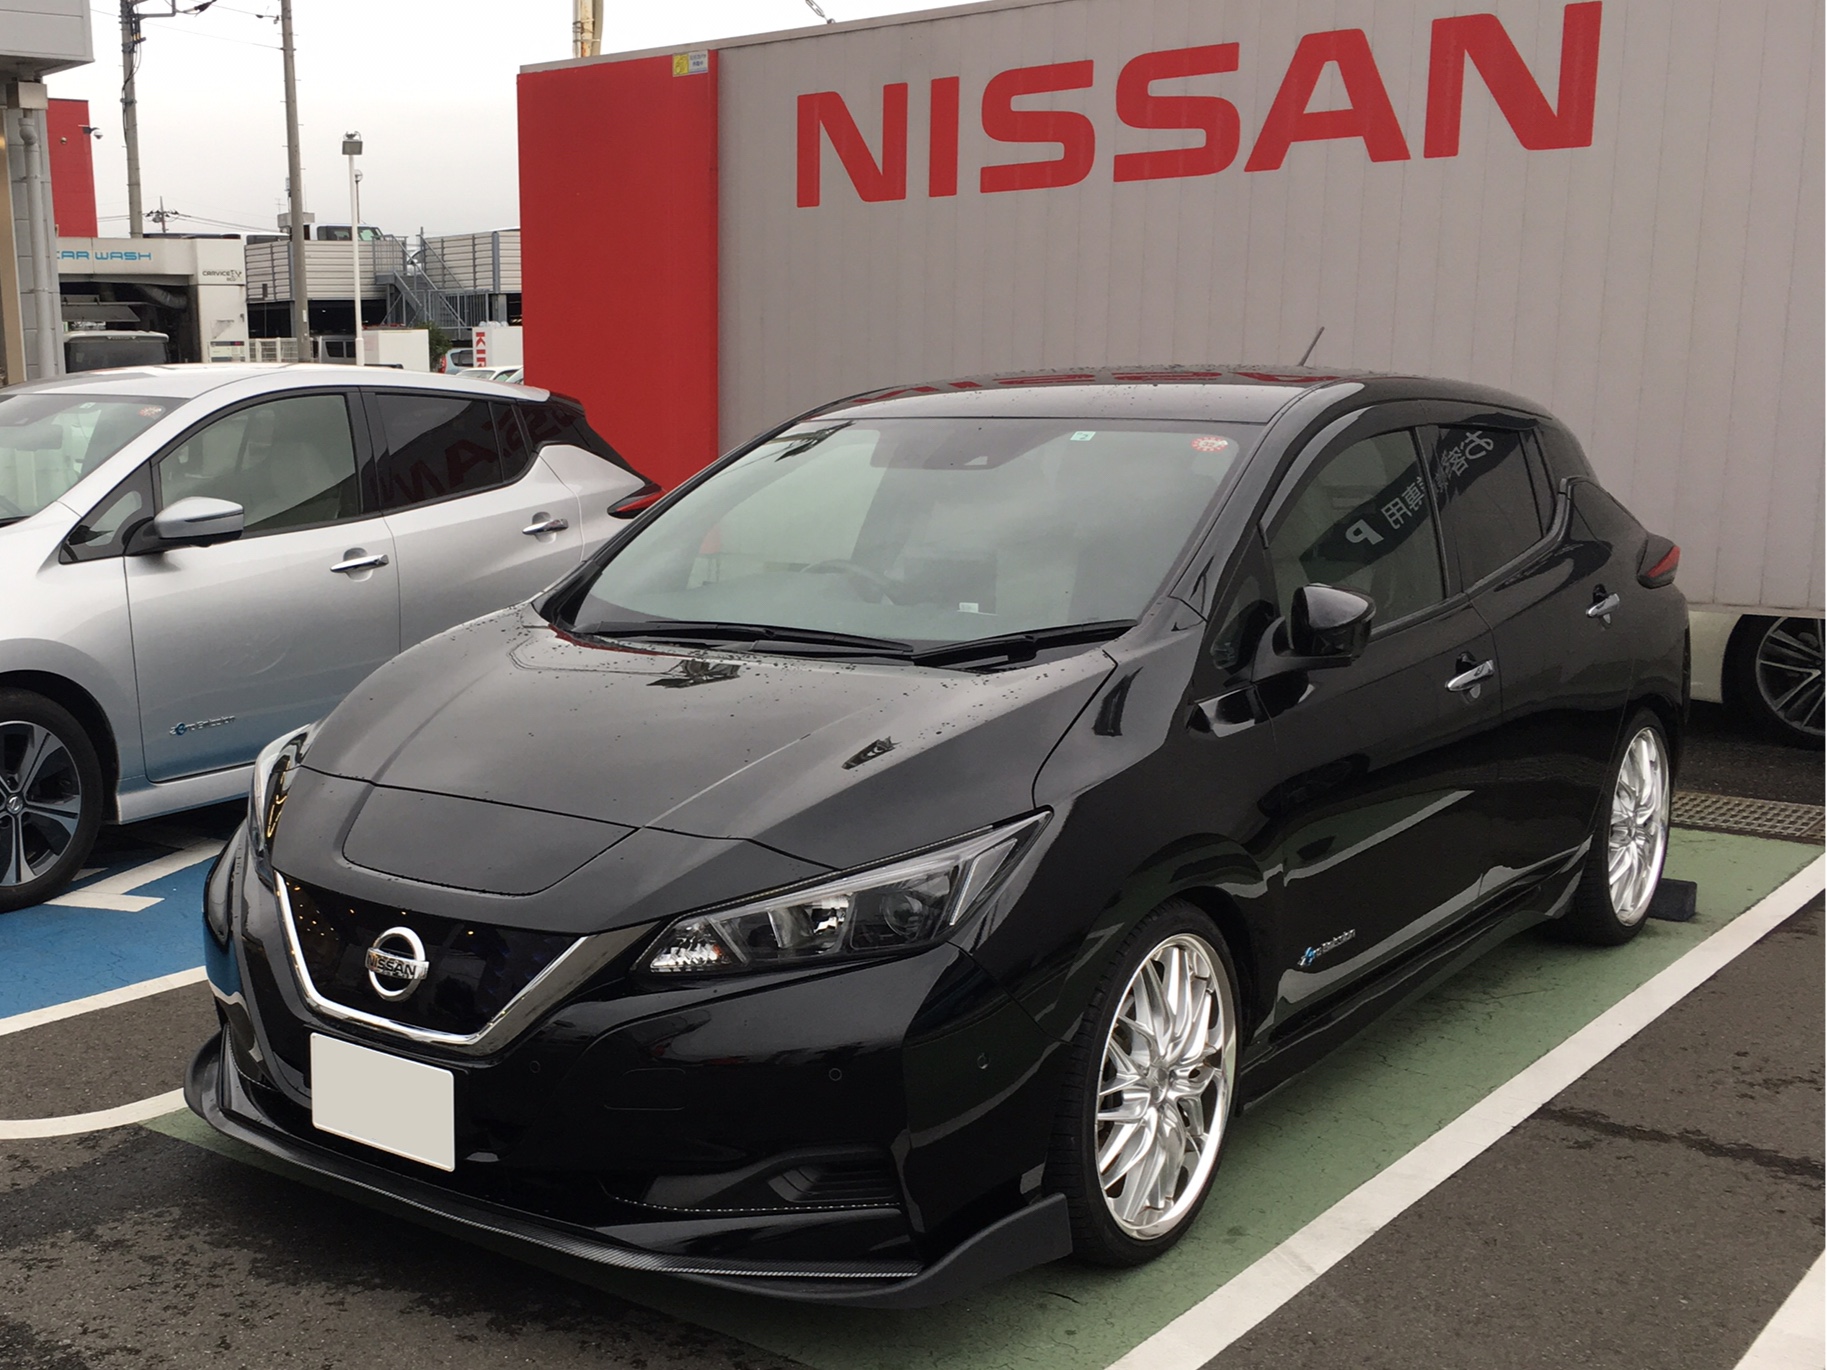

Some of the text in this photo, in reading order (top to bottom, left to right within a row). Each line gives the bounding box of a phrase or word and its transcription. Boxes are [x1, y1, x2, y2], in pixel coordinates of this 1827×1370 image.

[796, 2, 1602, 208] NISSAN
[57, 250, 152, 261] AR WASH
[368, 953, 417, 976] NISSAN
